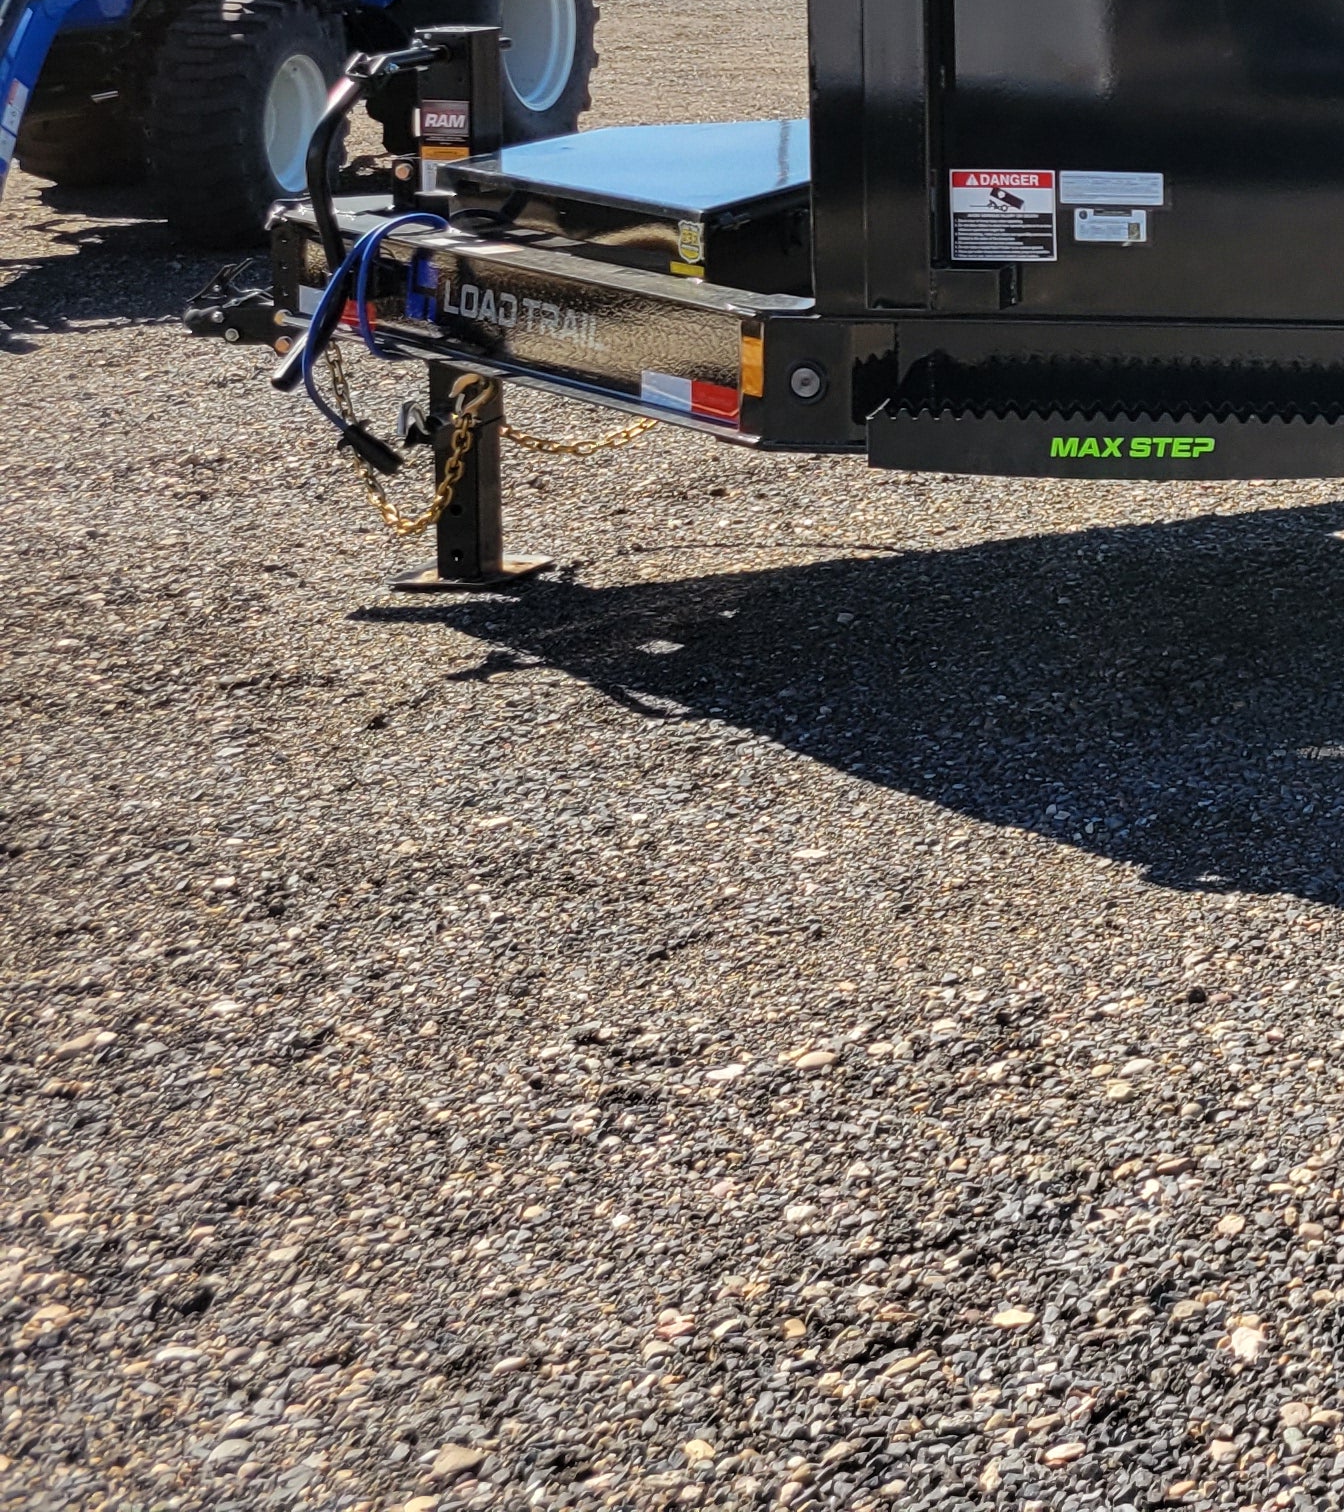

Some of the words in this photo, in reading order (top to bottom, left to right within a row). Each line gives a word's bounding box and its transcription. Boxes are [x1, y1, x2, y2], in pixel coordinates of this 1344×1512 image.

[424, 113, 466, 128] RAM
[980, 174, 1039, 186] DANGER
[443, 280, 518, 327] LOAD
[522, 297, 605, 351] TRAIL
[1050, 437, 1124, 457] MAX
[1129, 437, 1216, 457] STEP
